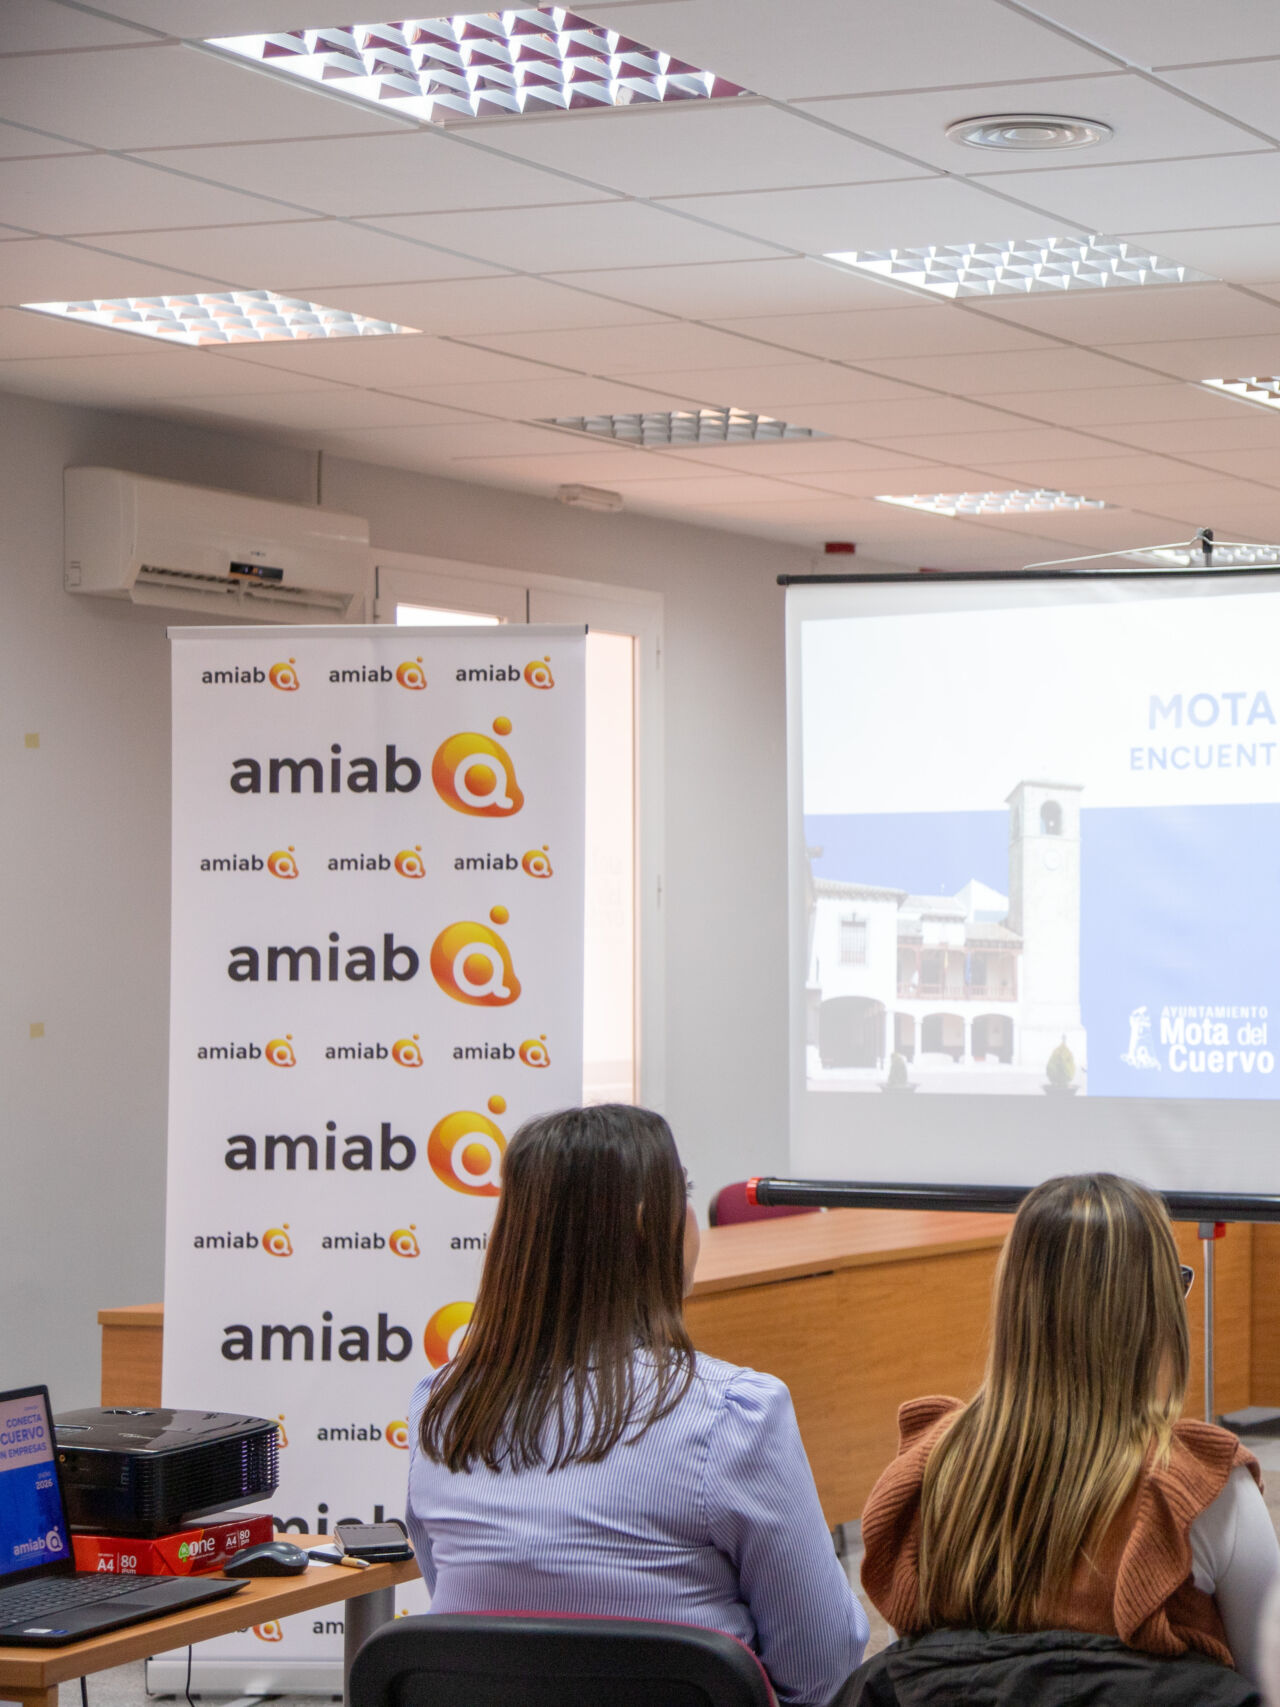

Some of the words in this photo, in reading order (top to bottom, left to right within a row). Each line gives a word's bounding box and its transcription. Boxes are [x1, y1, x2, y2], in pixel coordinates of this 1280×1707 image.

[201, 665, 266, 684] amiab
[329, 665, 394, 683] amiab
[455, 664, 521, 682] amiab
[1148, 691, 1277, 730] MOTA
[230, 743, 422, 794] amiab
[200, 853, 264, 871] amiab
[327, 853, 391, 871] amiab
[454, 852, 519, 870] amiab
[227, 931, 420, 982] amiab
[1161, 1005, 1269, 1019] AYUNTAMIENTO
[1160, 1016, 1230, 1046] Mota
[1236, 1021, 1268, 1046] del
[197, 1042, 262, 1060] amiab
[325, 1042, 389, 1060] amiab
[453, 1042, 516, 1060] amiab
[1168, 1044, 1276, 1074] Cuervo
[224, 1120, 417, 1171] amiab
[193, 1231, 259, 1249] amiab
[322, 1232, 386, 1250] amiab
[450, 1232, 487, 1250] ami
[221, 1310, 413, 1362] amiab
[6, 1413, 43, 1429] CONECTA
[0, 1425, 45, 1446] CUERVO
[317, 1423, 382, 1441] amiab
[8, 1441, 47, 1458] EMPRESAS
[13, 1537, 46, 1556] amiab
[225, 1536, 237, 1548] A4
[97, 1558, 114, 1572] A4
[121, 1555, 138, 1569] 80
